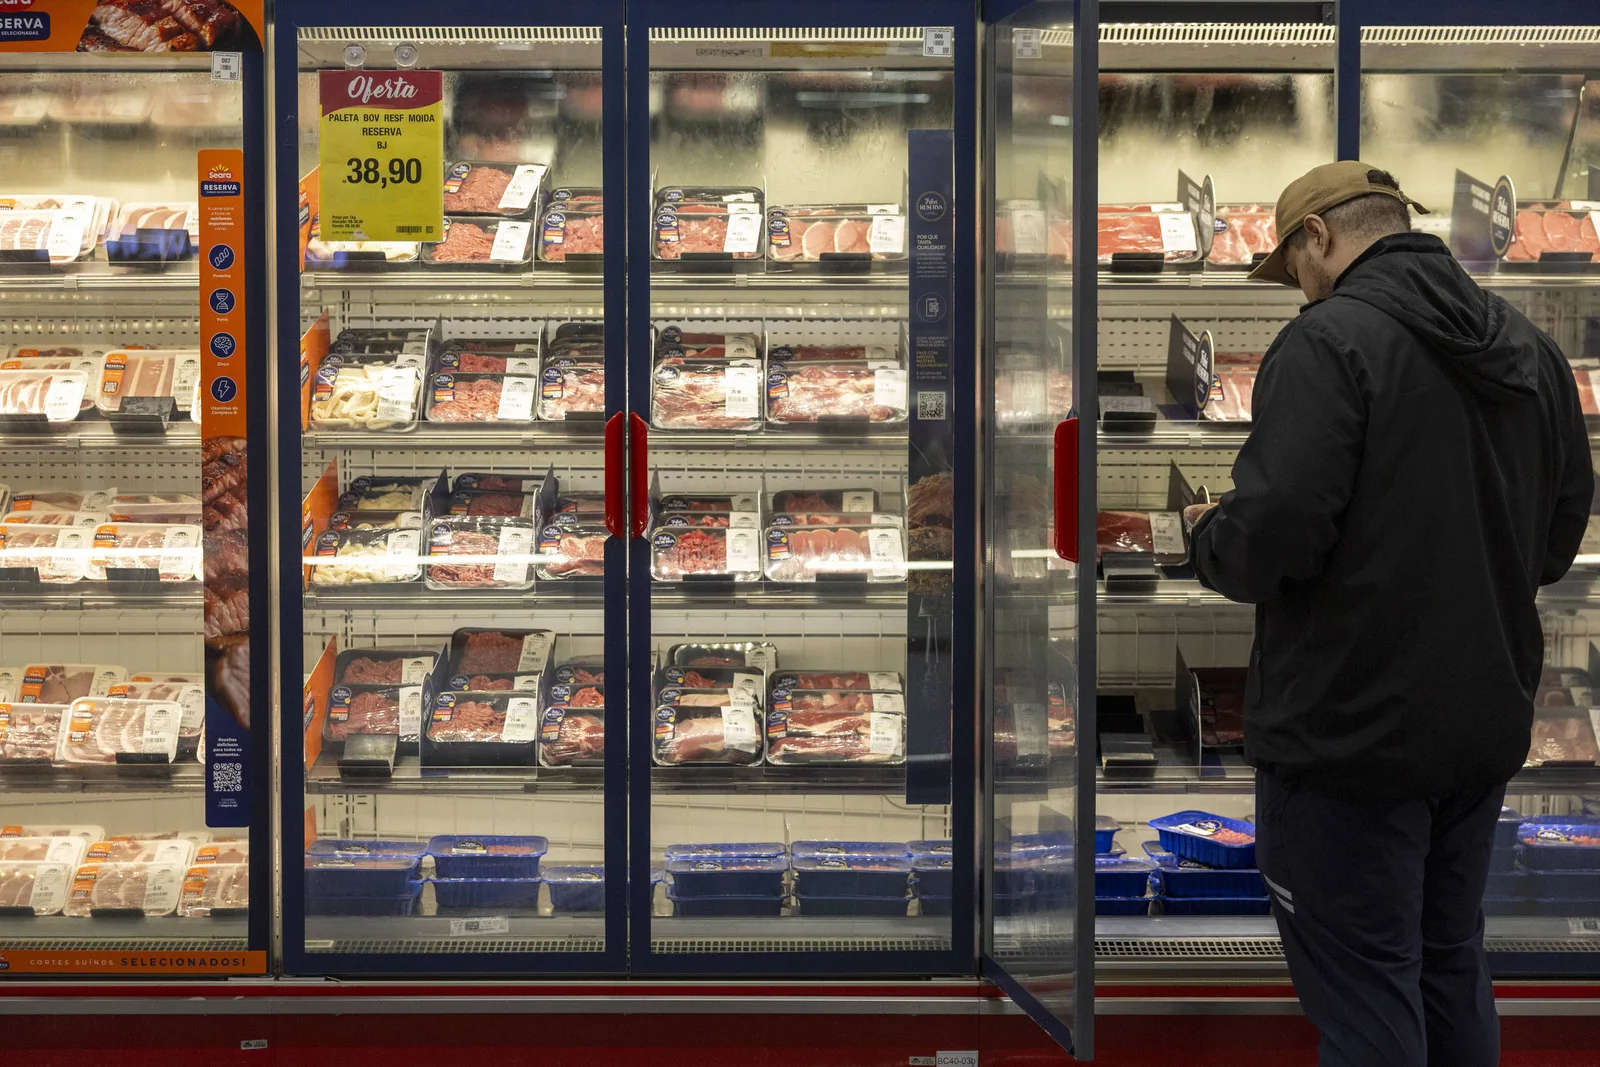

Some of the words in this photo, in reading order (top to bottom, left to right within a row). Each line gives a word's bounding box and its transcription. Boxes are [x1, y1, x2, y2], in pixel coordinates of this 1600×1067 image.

[348, 76, 418, 104] Oferta
[328, 113, 359, 122] PALETA
[363, 113, 380, 122] BOV
[384, 113, 404, 122] RESF
[408, 113, 435, 122] MOIDA
[362, 127, 402, 136] RESERVA
[377, 141, 387, 149] BJ
[346, 158, 422, 189] 38,90
[76, 957, 114, 966] SUÍNOS
[120, 958, 246, 966] SELECIONADOS!
